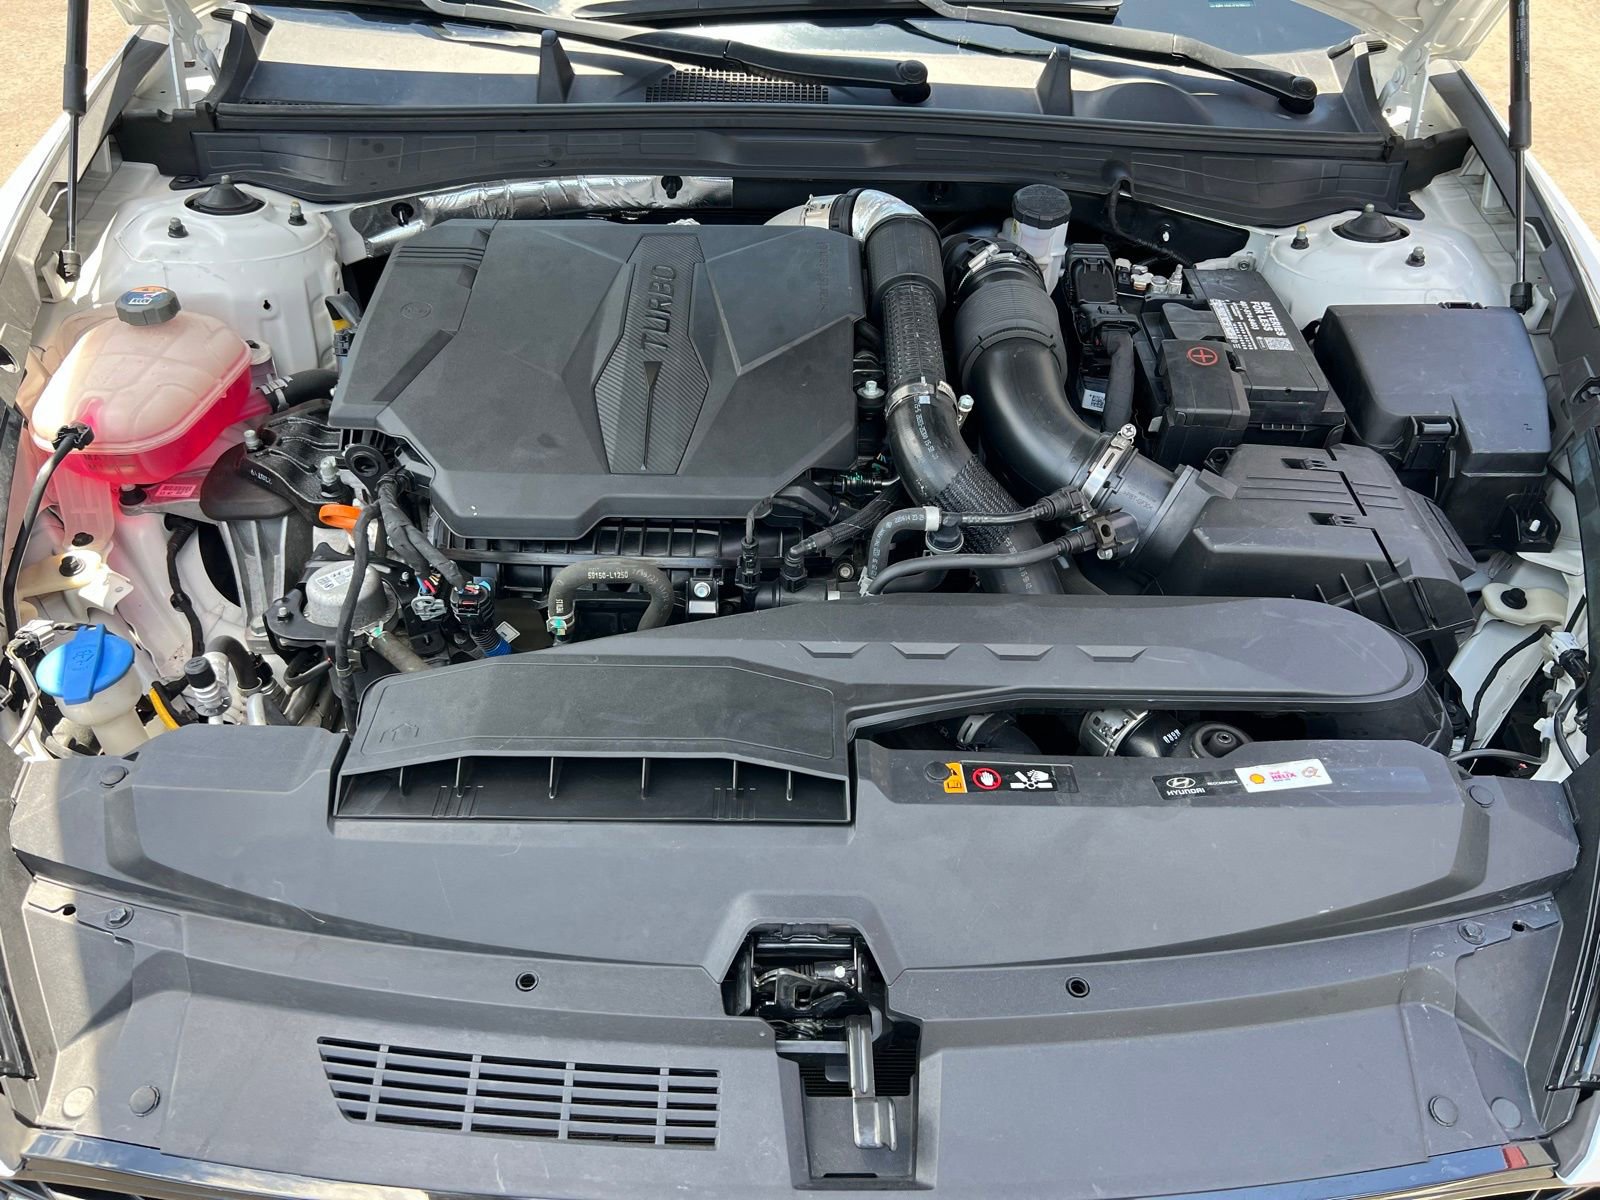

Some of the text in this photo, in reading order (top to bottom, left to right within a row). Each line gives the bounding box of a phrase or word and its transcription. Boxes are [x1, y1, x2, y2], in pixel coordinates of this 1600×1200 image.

[641, 265, 677, 351] TURBO
[1250, 301, 1265, 315] FOR
[1257, 314, 1274, 332] LESS
[1260, 301, 1287, 337] BATTERIES
[1166, 787, 1206, 796] HYUNDAI
